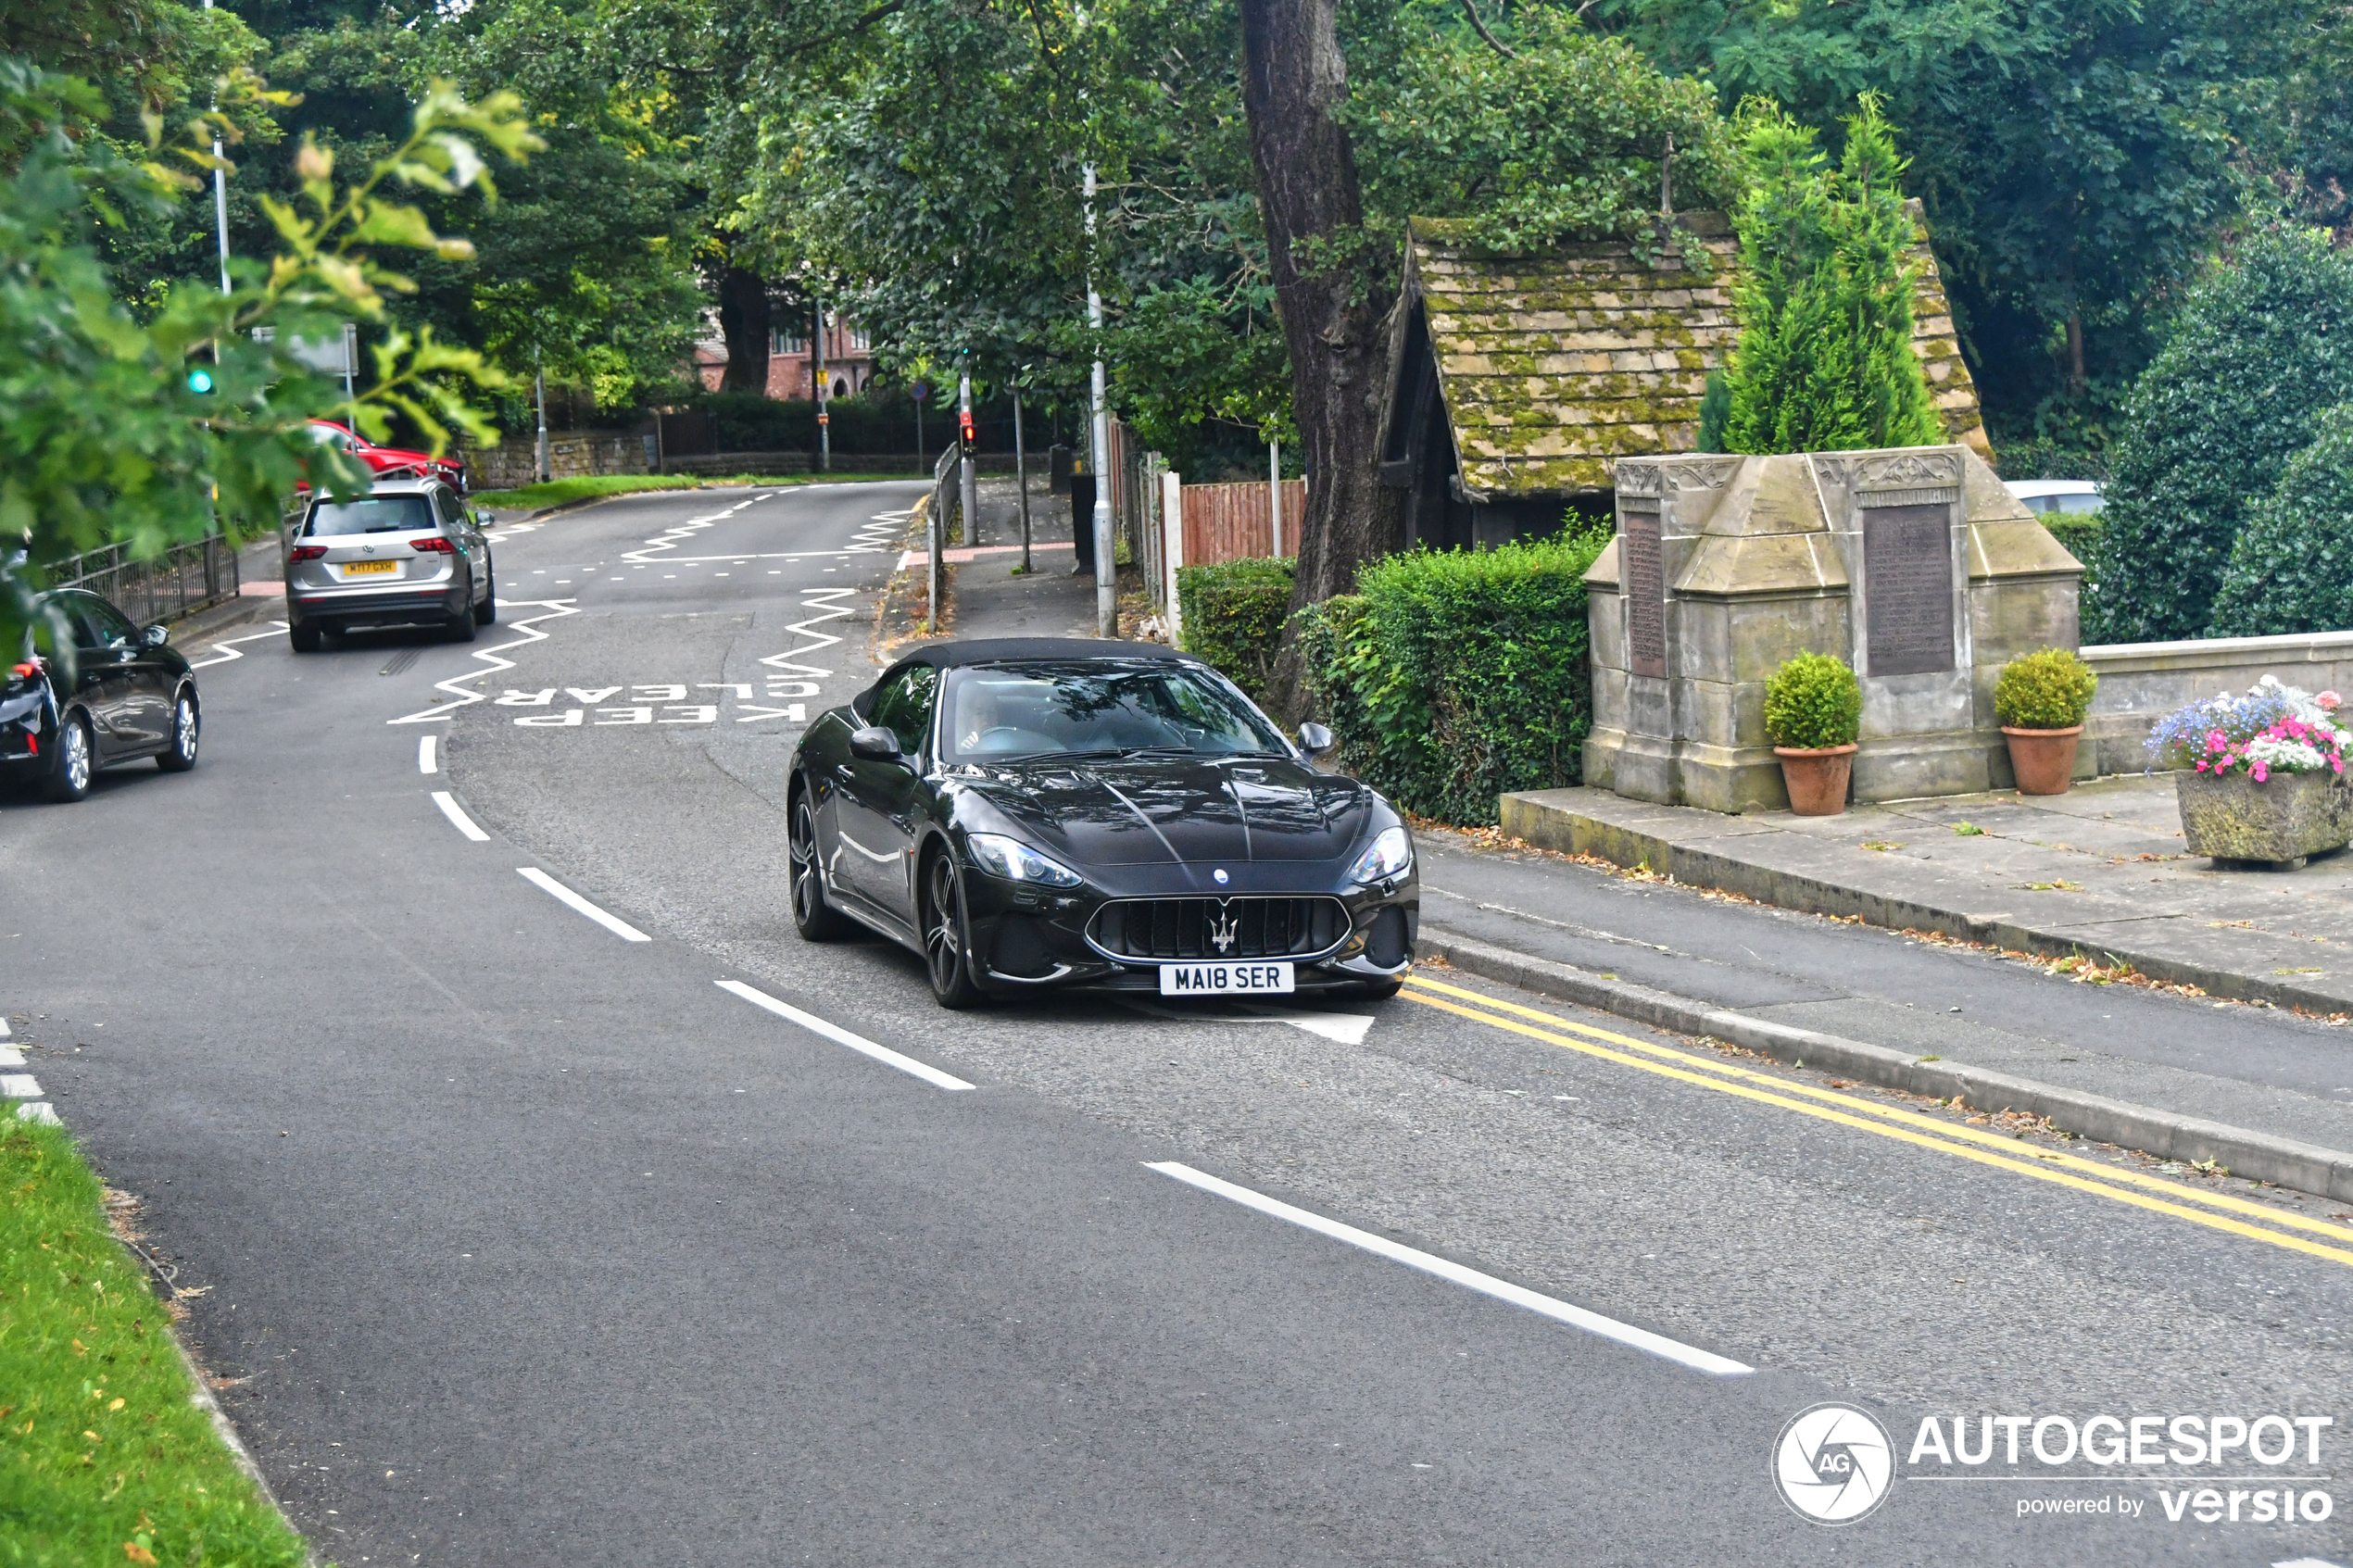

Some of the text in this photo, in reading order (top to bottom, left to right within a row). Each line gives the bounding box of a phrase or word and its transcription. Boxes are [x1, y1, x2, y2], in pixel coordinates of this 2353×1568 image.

[373, 561, 392, 571] GXH
[494, 682, 820, 706] CLEAR
[513, 704, 806, 726] KEEP
[1175, 966, 1280, 990] MA18 SER
